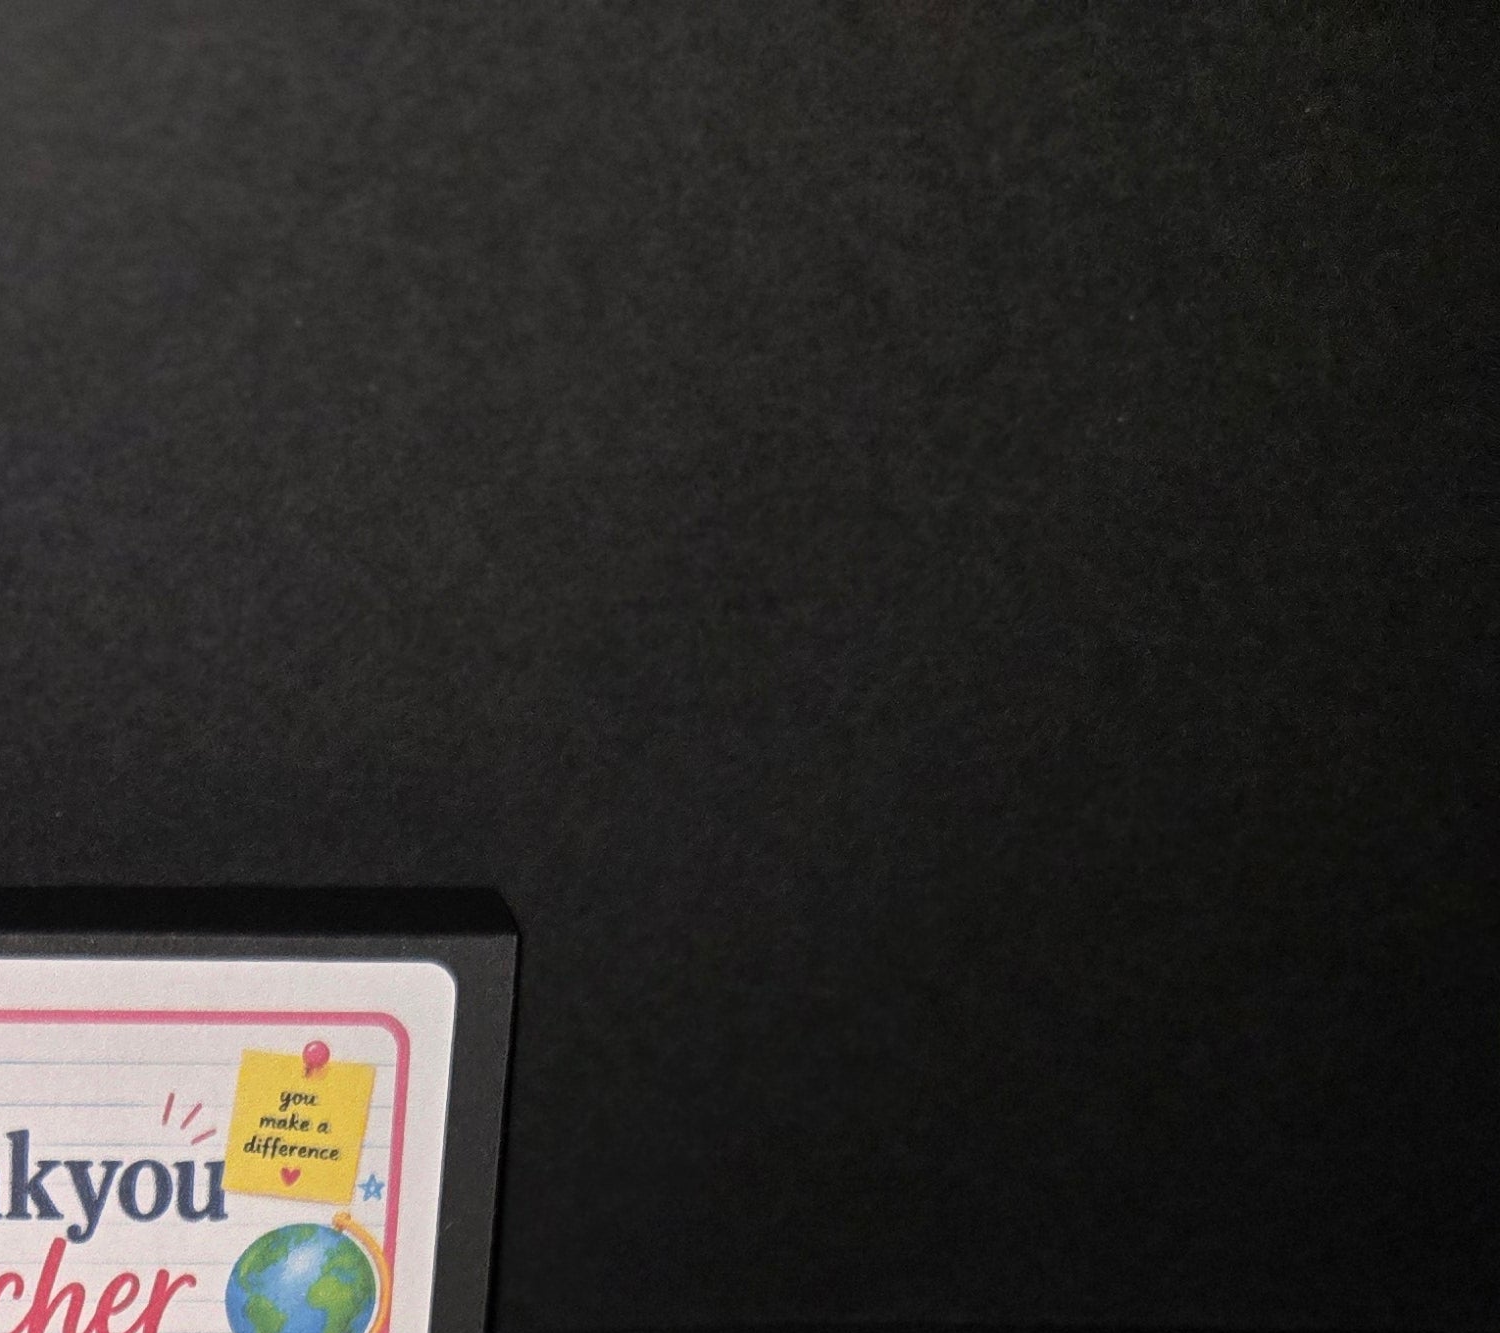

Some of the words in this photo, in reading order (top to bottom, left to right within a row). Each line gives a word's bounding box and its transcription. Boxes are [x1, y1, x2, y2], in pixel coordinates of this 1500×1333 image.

[279, 1091, 317, 1112] you
[259, 1113, 310, 1131] make
[317, 1122, 329, 1134] a
[243, 1135, 340, 1161] difference
